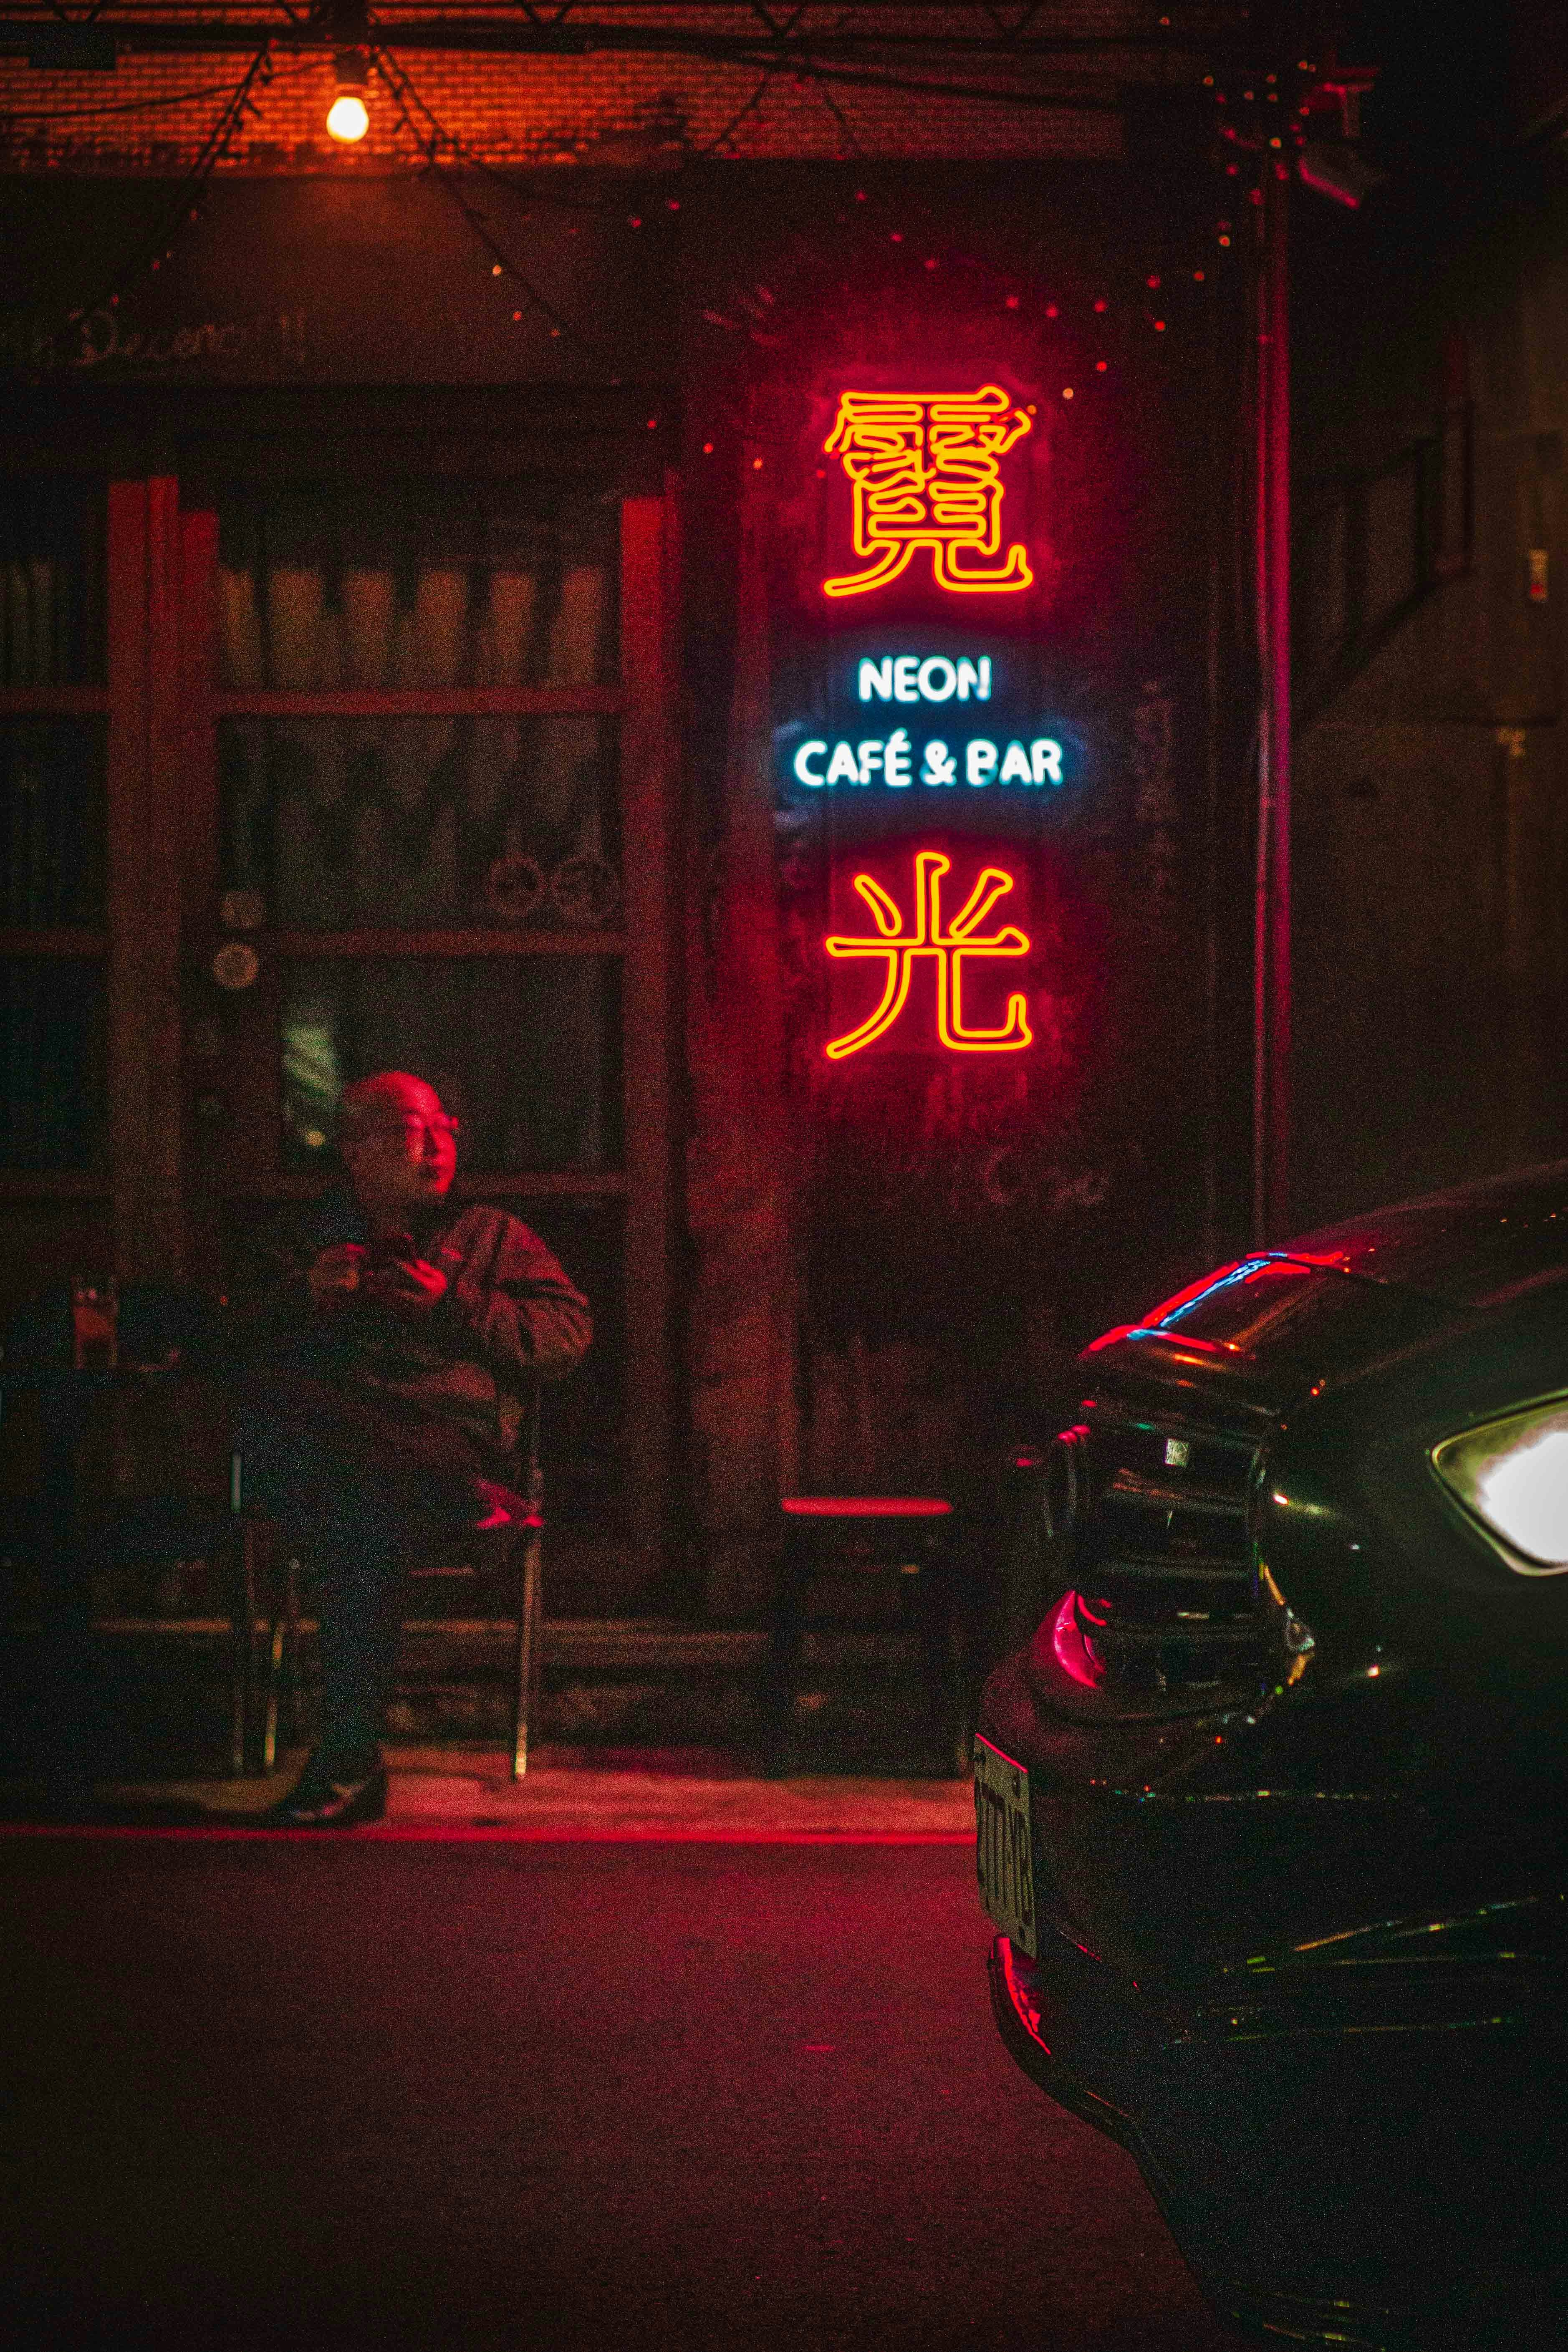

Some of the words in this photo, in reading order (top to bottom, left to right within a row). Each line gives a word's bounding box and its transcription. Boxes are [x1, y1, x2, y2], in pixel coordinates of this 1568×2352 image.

[857, 655, 992, 704] NEON
[793, 727, 913, 788] CAFÉ
[919, 738, 957, 788] &
[965, 738, 1063, 788] BAR
[825, 851, 1033, 1059] 光
